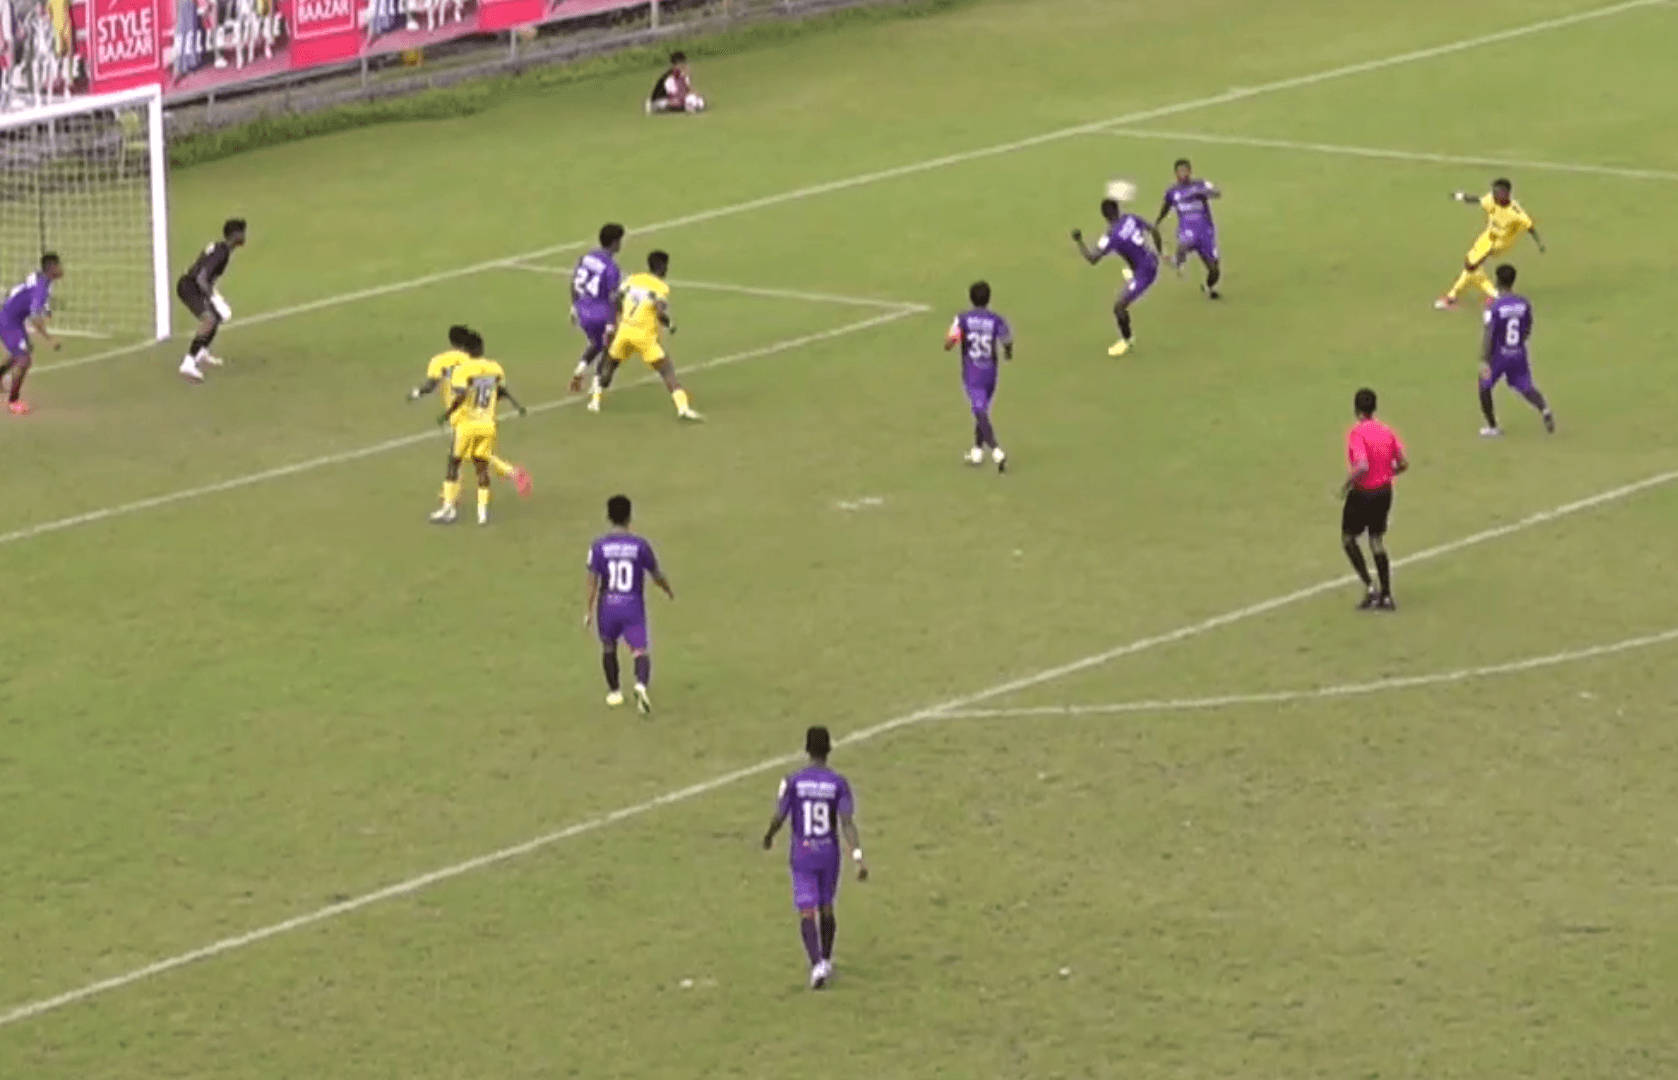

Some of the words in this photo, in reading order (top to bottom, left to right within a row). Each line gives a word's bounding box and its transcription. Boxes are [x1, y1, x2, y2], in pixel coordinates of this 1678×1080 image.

[97, 7, 152, 43] STYLE
[98, 34, 153, 63] BAAZAR
[573, 266, 600, 298] 24
[967, 332, 992, 358] 35
[1506, 318, 1520, 346] 6
[607, 559, 633, 592] 10
[803, 800, 830, 836] 19
